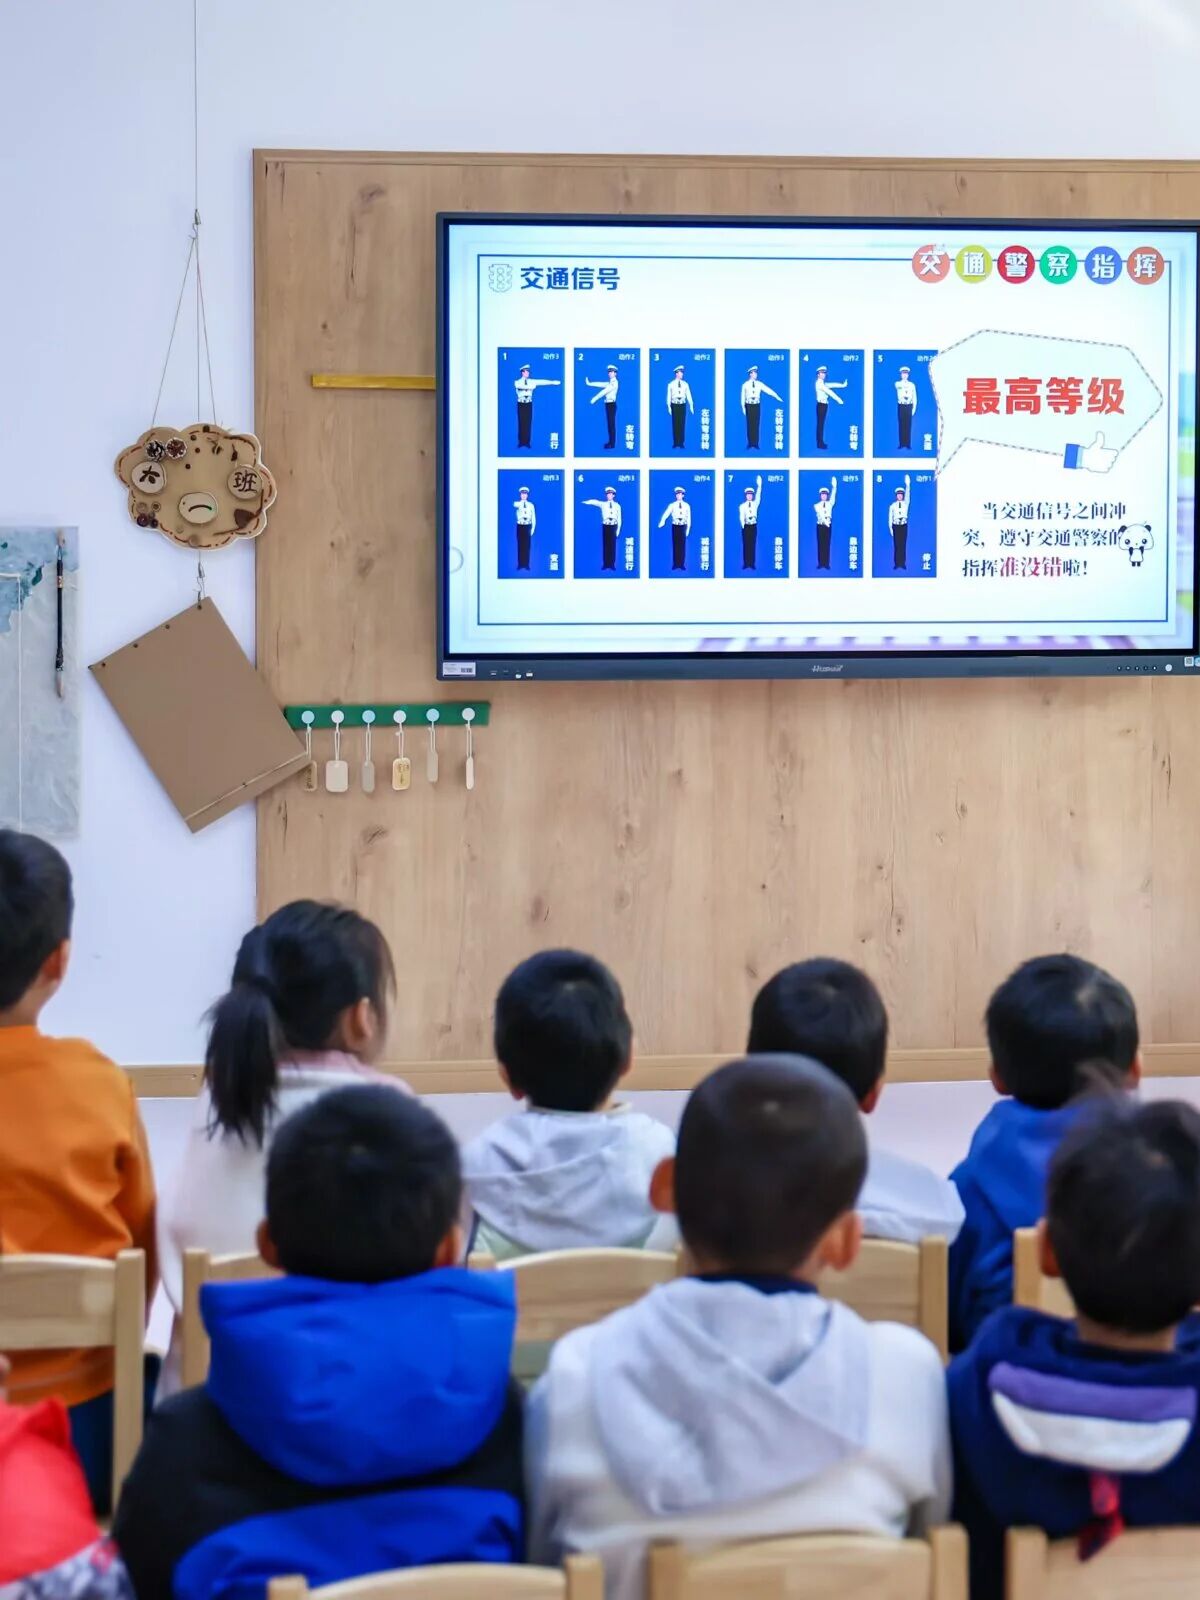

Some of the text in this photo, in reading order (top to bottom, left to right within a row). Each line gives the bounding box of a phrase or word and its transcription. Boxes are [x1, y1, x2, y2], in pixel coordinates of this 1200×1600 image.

[918, 250, 1158, 279] 交通警察指挥
[521, 267, 620, 290] 交通信号
[503, 352, 507, 360] 1
[578, 353, 584, 361] 2
[654, 353, 660, 361] 3
[803, 354, 809, 362] 4
[878, 354, 883, 362] 5
[963, 377, 1124, 415] 最高等级
[233, 469, 258, 493] 班
[578, 474, 584, 483] 6
[728, 474, 734, 482] 7
[876, 475, 883, 483] 8
[983, 501, 1126, 521] 当交通信号之间冲
[922, 552, 932, 570] 停止
